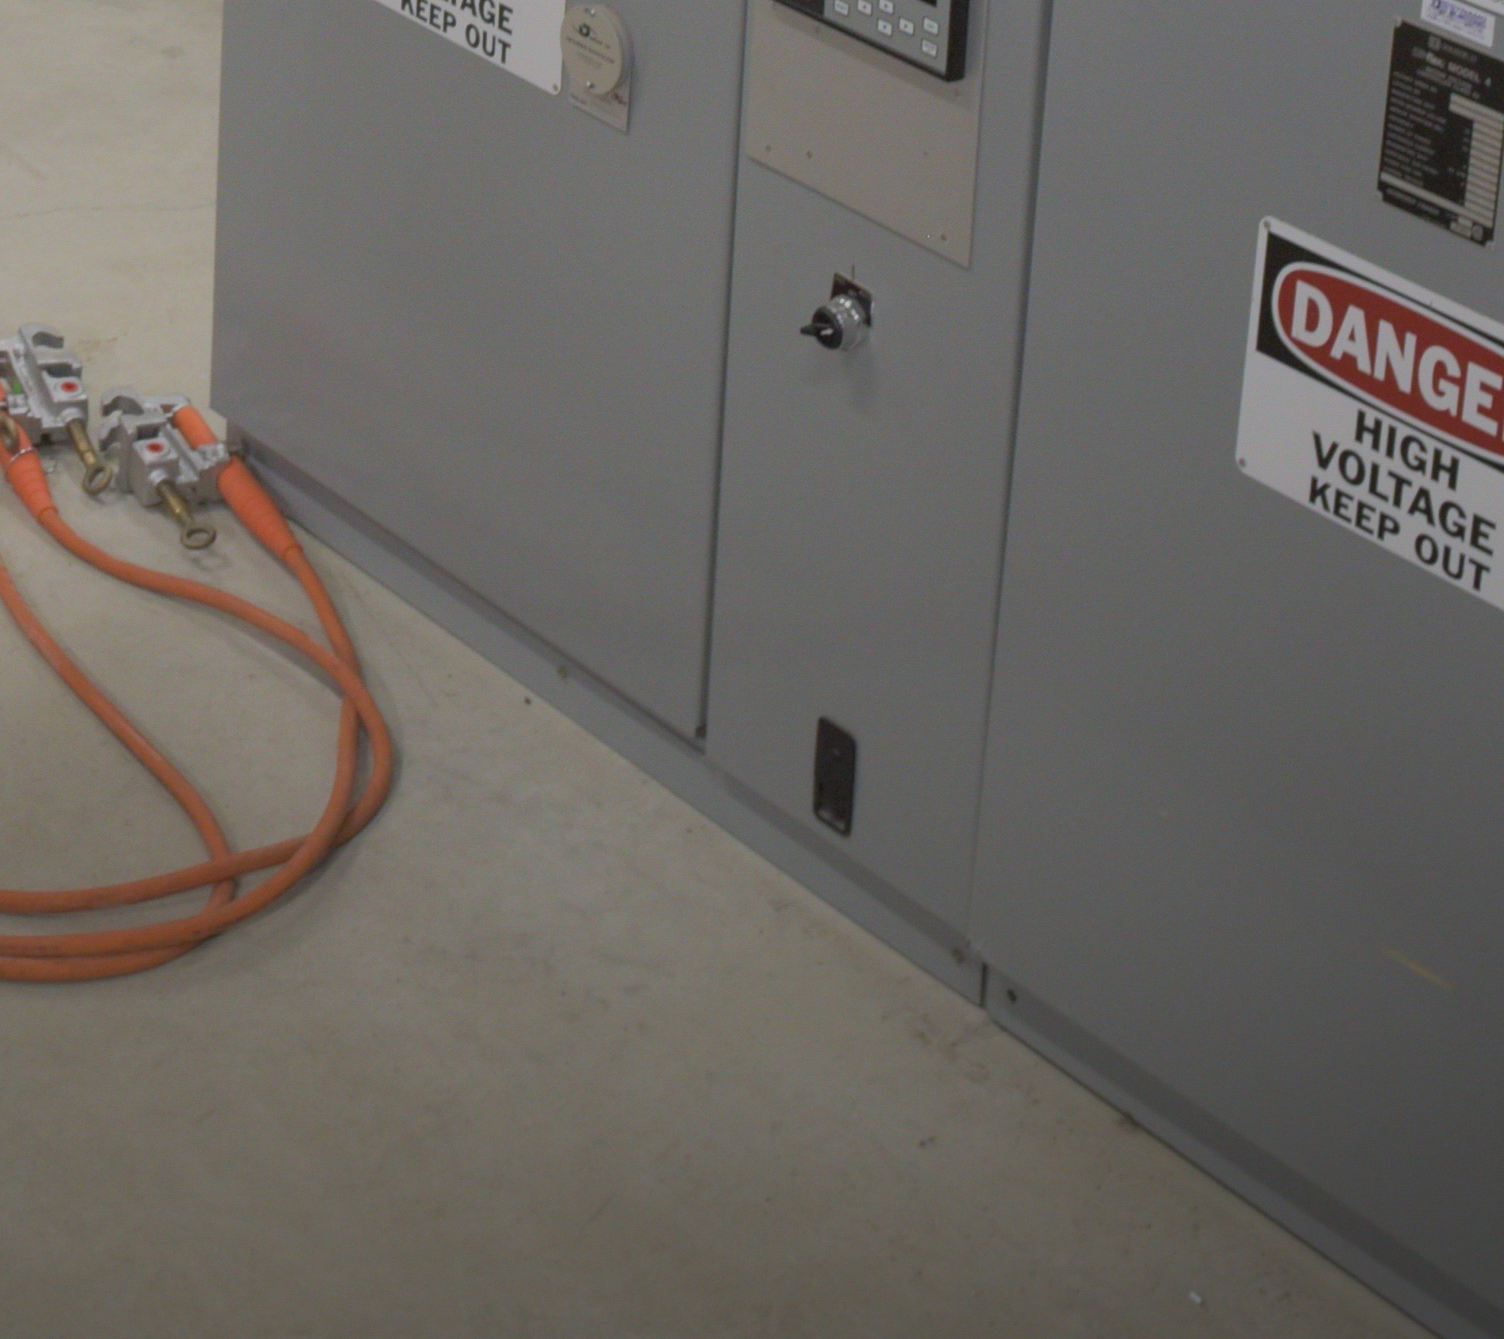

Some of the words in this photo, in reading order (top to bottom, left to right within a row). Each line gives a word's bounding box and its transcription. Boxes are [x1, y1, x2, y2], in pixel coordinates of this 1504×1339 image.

[464, 23, 512, 65] OUT
[1311, 430, 1497, 558] VOLTAGE
[1353, 408, 1461, 492] HIGH
[1308, 476, 1401, 545] KEEP
[1414, 532, 1492, 593] OUT
